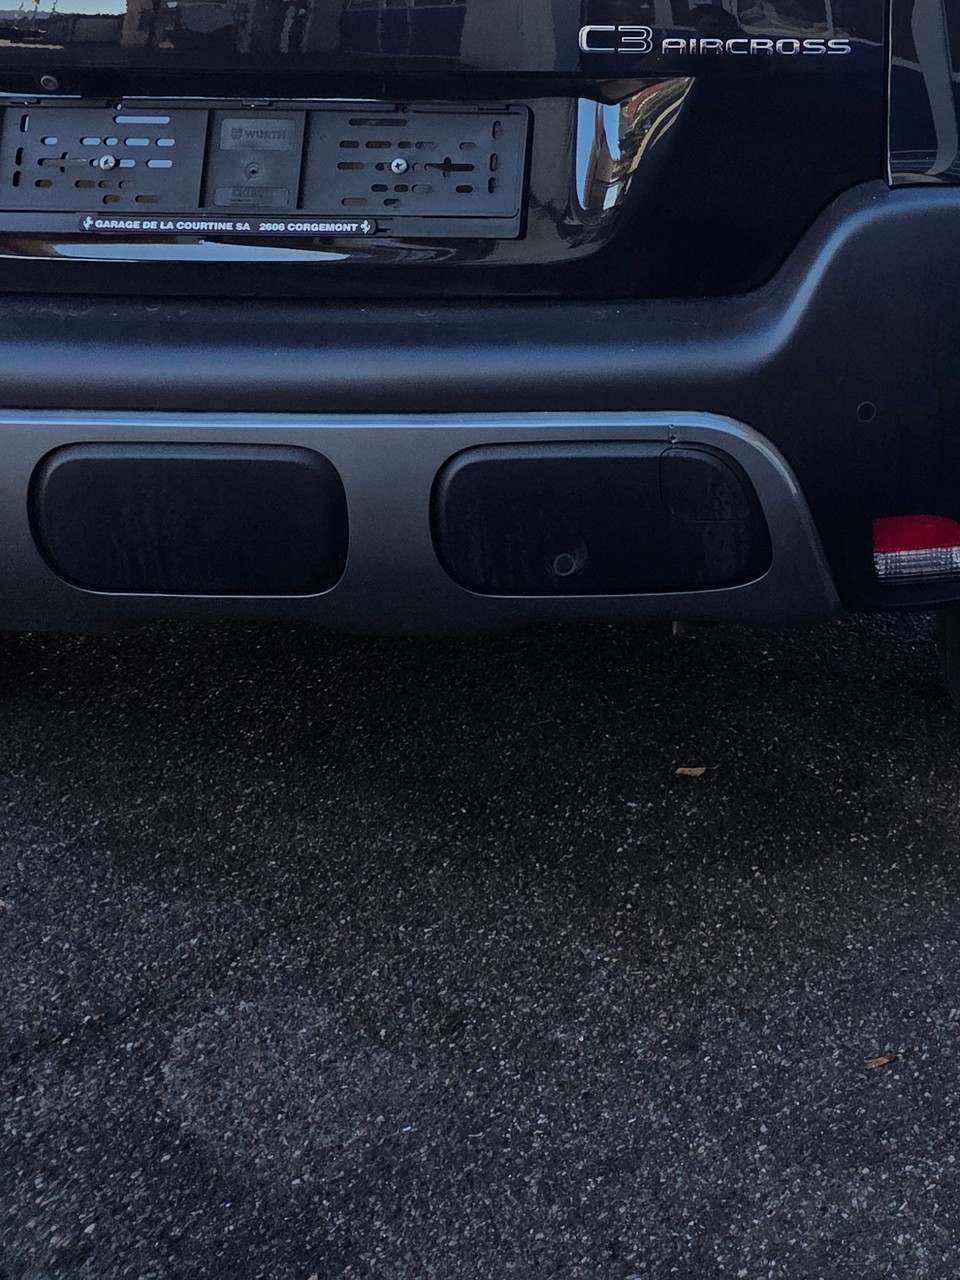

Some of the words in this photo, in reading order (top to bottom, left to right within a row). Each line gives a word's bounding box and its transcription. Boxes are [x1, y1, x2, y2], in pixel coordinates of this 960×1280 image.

[578, 25, 653, 54] C3
[661, 38, 851, 55] AIRCROSS
[95, 220, 140, 229] GARAGE
[142, 221, 158, 229] DE
[160, 221, 174, 230] LA
[176, 221, 233, 231] COURTINE
[235, 222, 250, 231] SA
[259, 222, 286, 232] 2606
[287, 222, 358, 233] CORGEMONT
